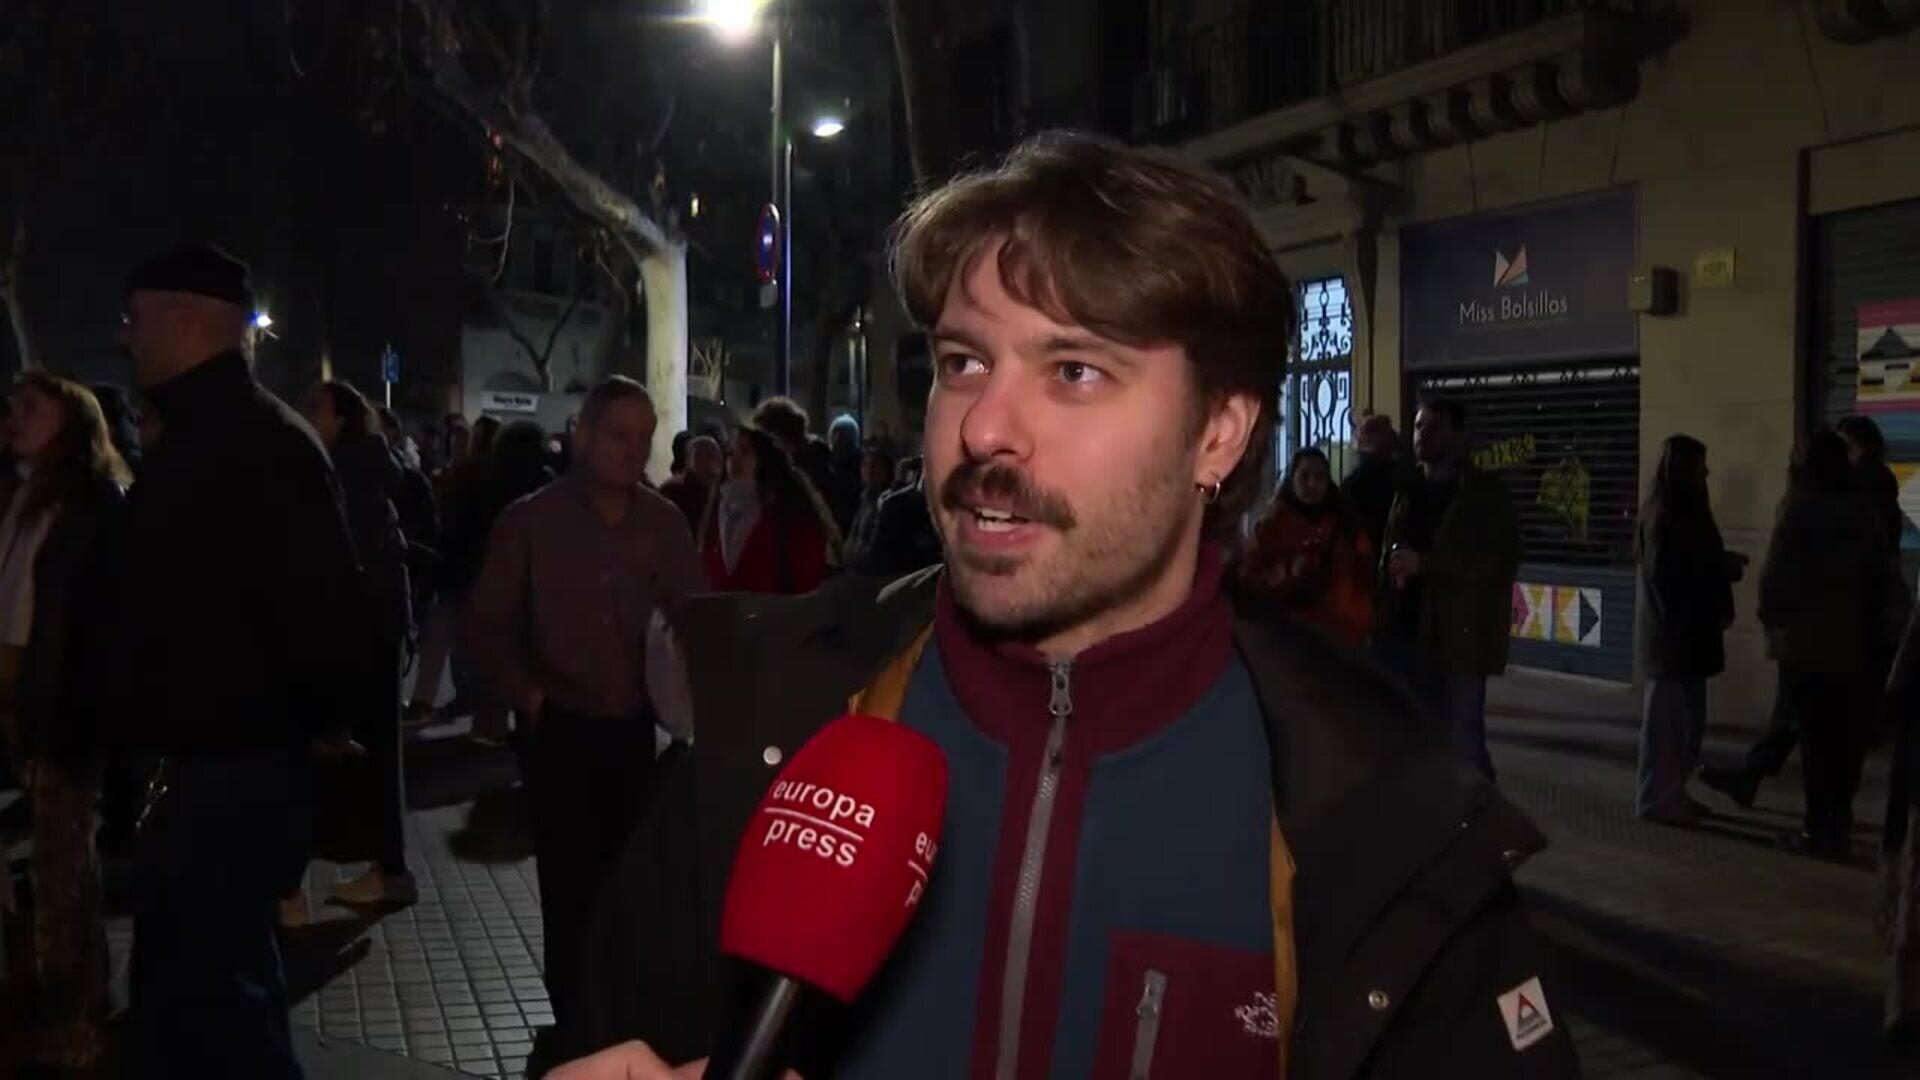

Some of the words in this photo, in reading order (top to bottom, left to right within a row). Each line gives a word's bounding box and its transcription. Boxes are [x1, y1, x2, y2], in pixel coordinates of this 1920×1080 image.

[1460, 301, 1494, 324] Miss
[1501, 289, 1567, 319] Bolsillos
[773, 780, 876, 828] europa
[763, 819, 857, 867] press
